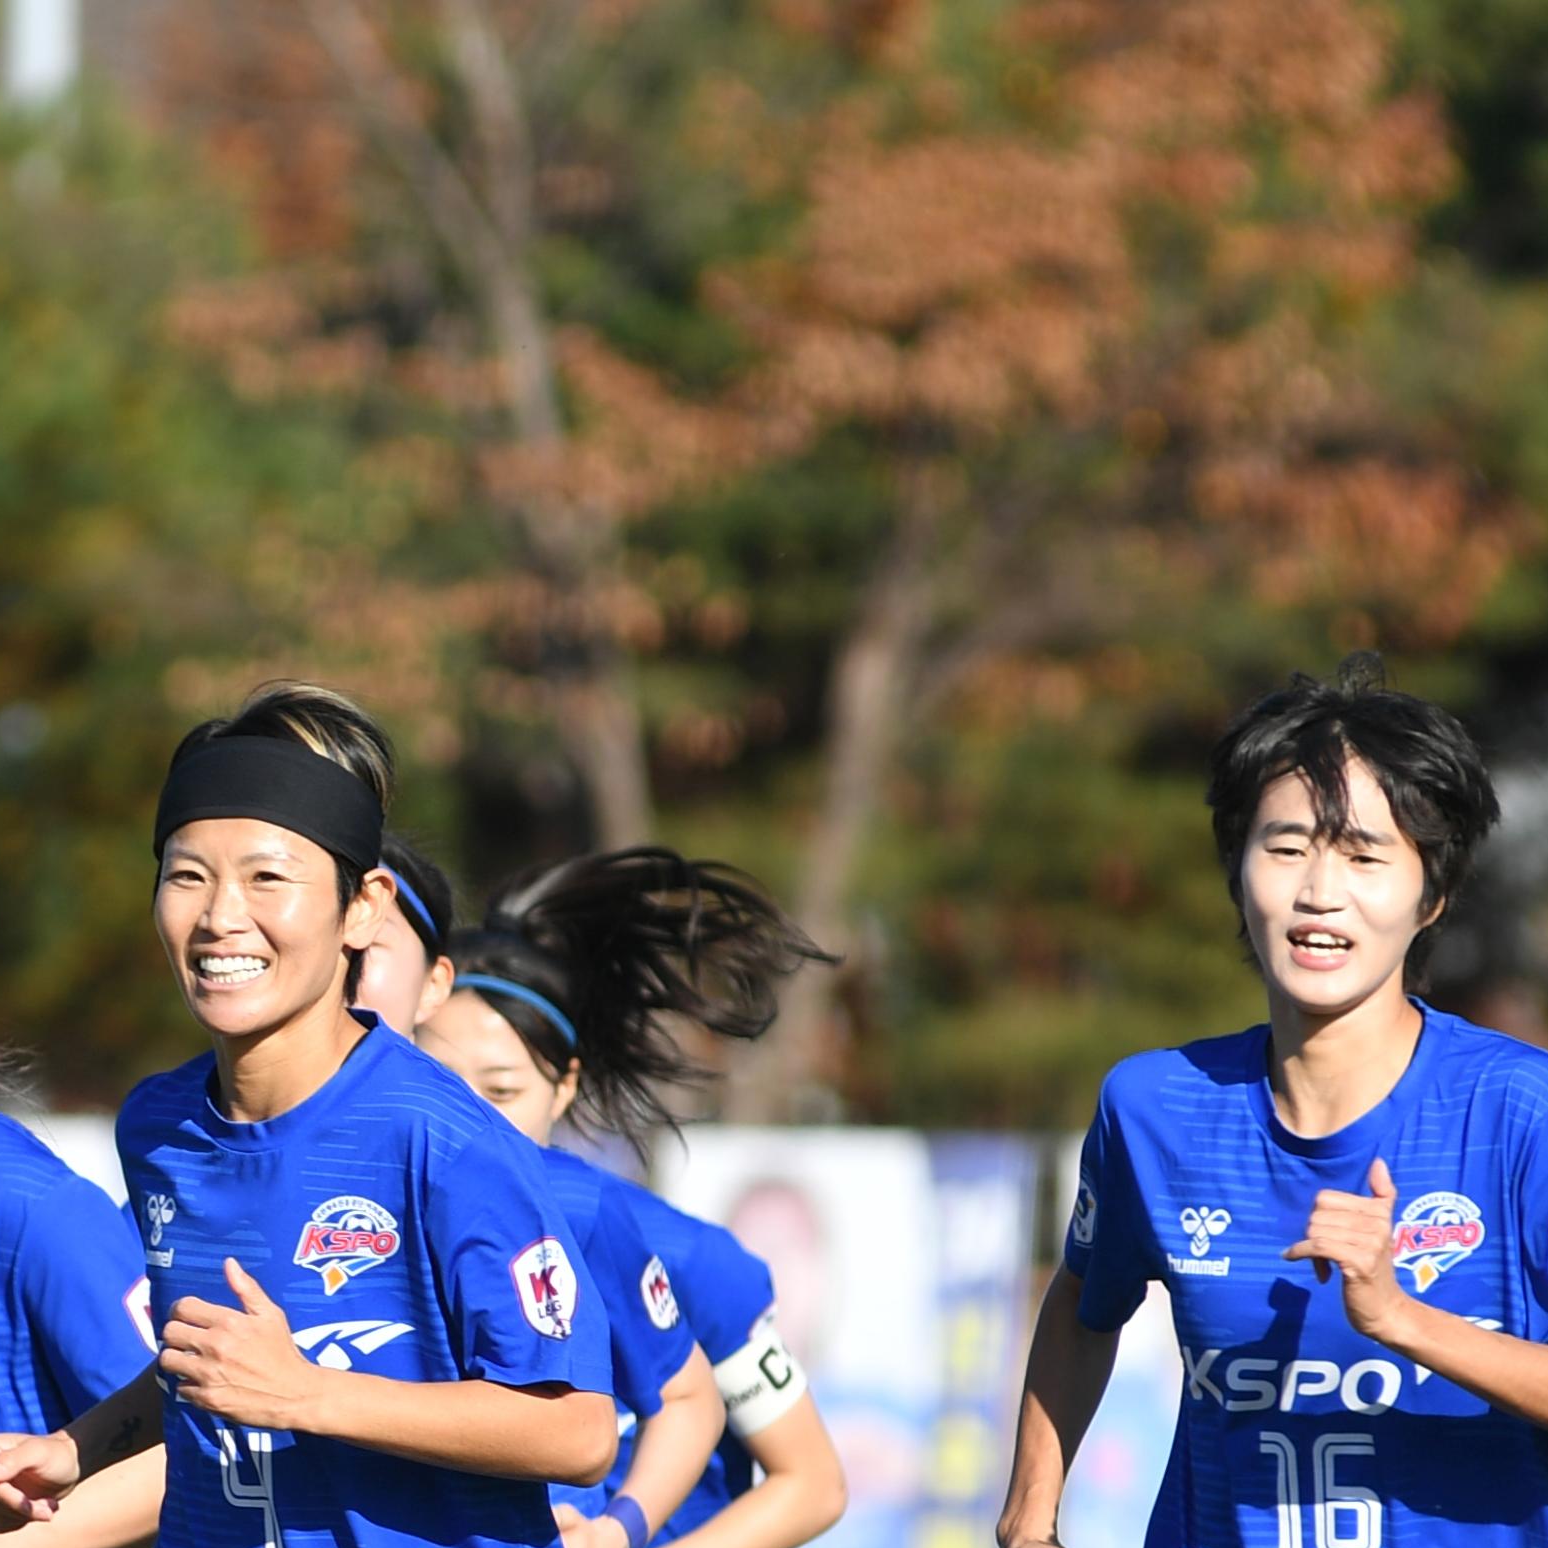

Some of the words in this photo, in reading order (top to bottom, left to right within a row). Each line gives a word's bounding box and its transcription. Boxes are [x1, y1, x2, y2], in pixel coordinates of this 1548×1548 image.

[301, 1226, 398, 1259] KSPO
[1395, 1222, 1481, 1257] KSPO
[1167, 1253, 1230, 1276] hummel
[759, 1346, 792, 1390] C
[1182, 1346, 1402, 1414] KSPO
